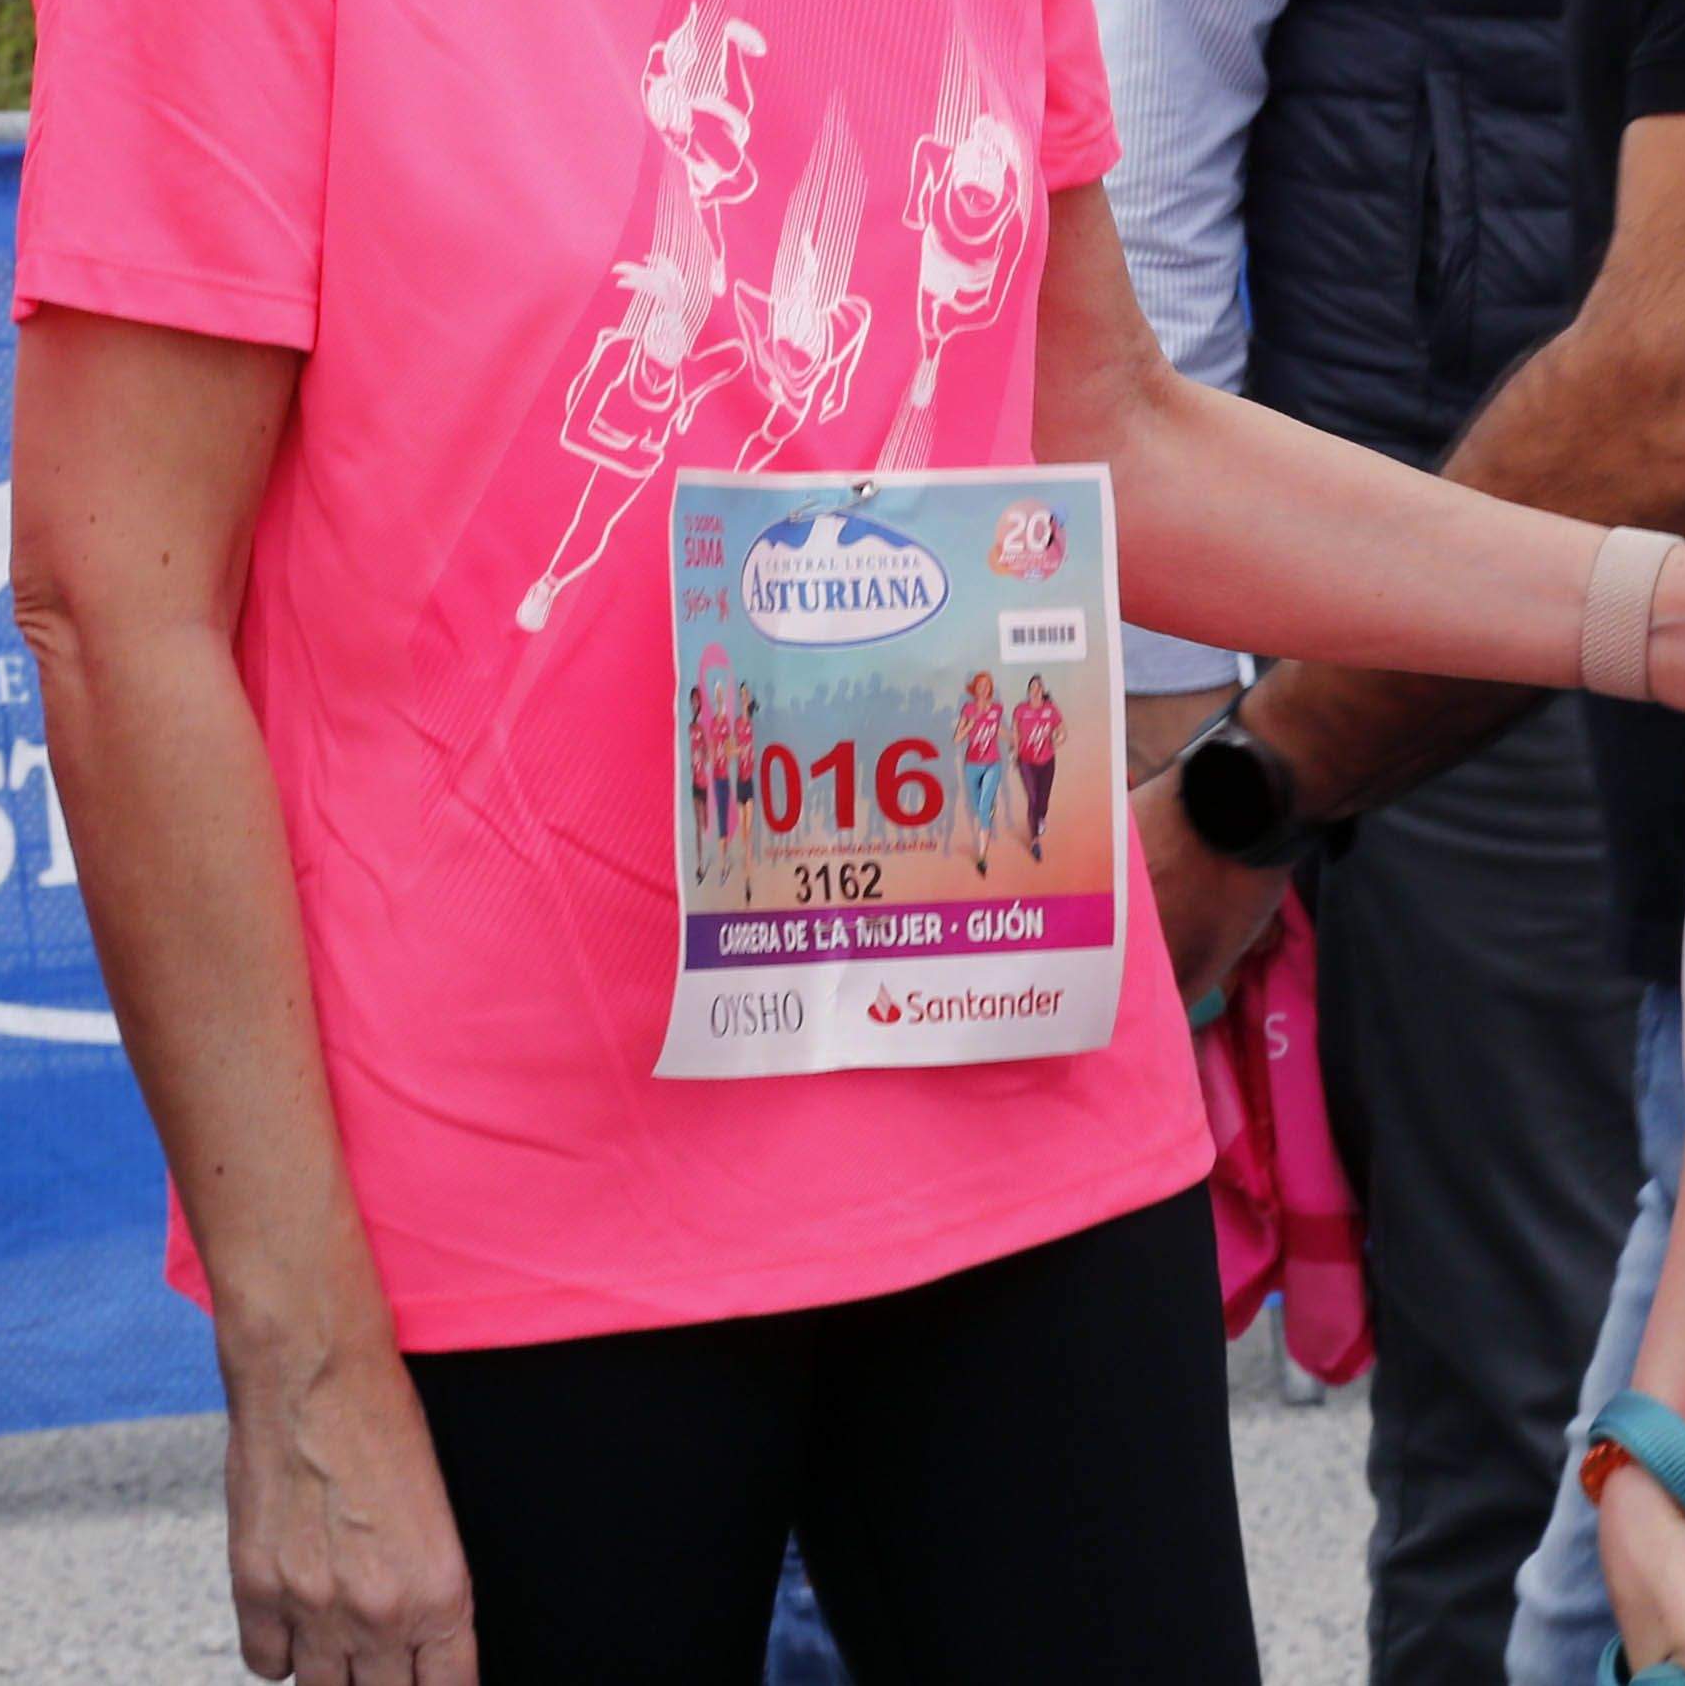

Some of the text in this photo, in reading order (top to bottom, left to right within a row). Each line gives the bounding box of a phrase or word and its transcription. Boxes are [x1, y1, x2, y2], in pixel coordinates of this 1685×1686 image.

[1001, 509, 1053, 554] 20
[749, 563, 931, 614] ASTURIANA
[759, 735, 945, 834] 016
[793, 859, 884, 904] 3162
[718, 897, 1045, 957] CARRERA DE LA MUJER GIJÓN
[709, 987, 805, 1040] OYSHO
[905, 984, 1065, 1025] Santander
